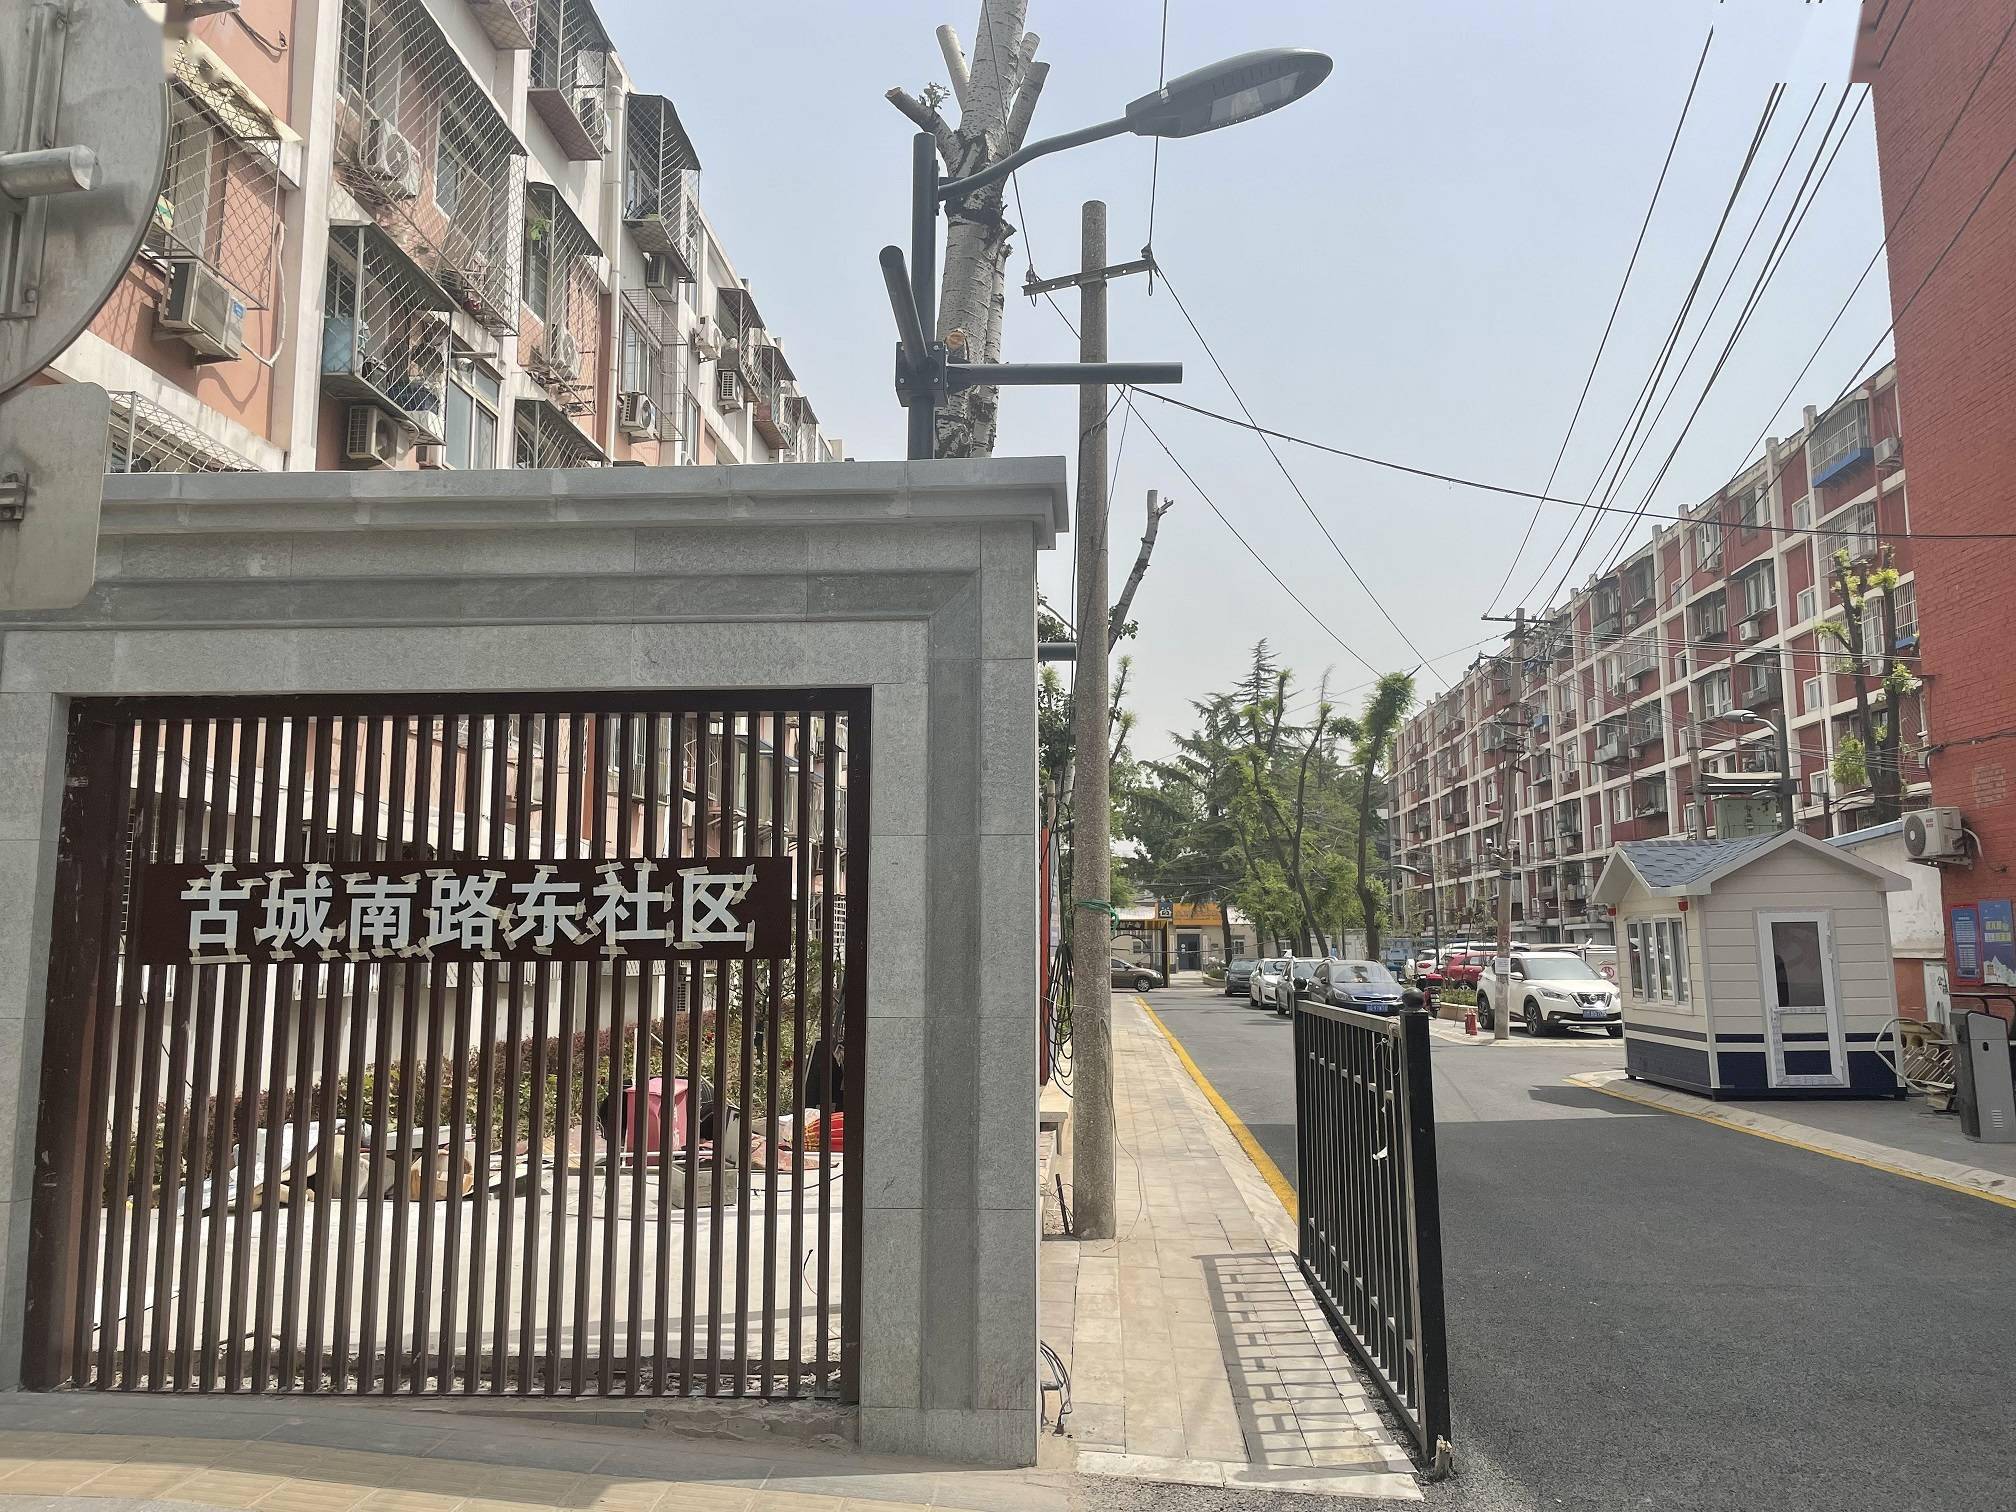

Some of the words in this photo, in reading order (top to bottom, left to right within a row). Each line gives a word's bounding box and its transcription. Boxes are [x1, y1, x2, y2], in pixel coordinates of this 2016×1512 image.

[180, 864, 748, 950] 古城南路东社区
